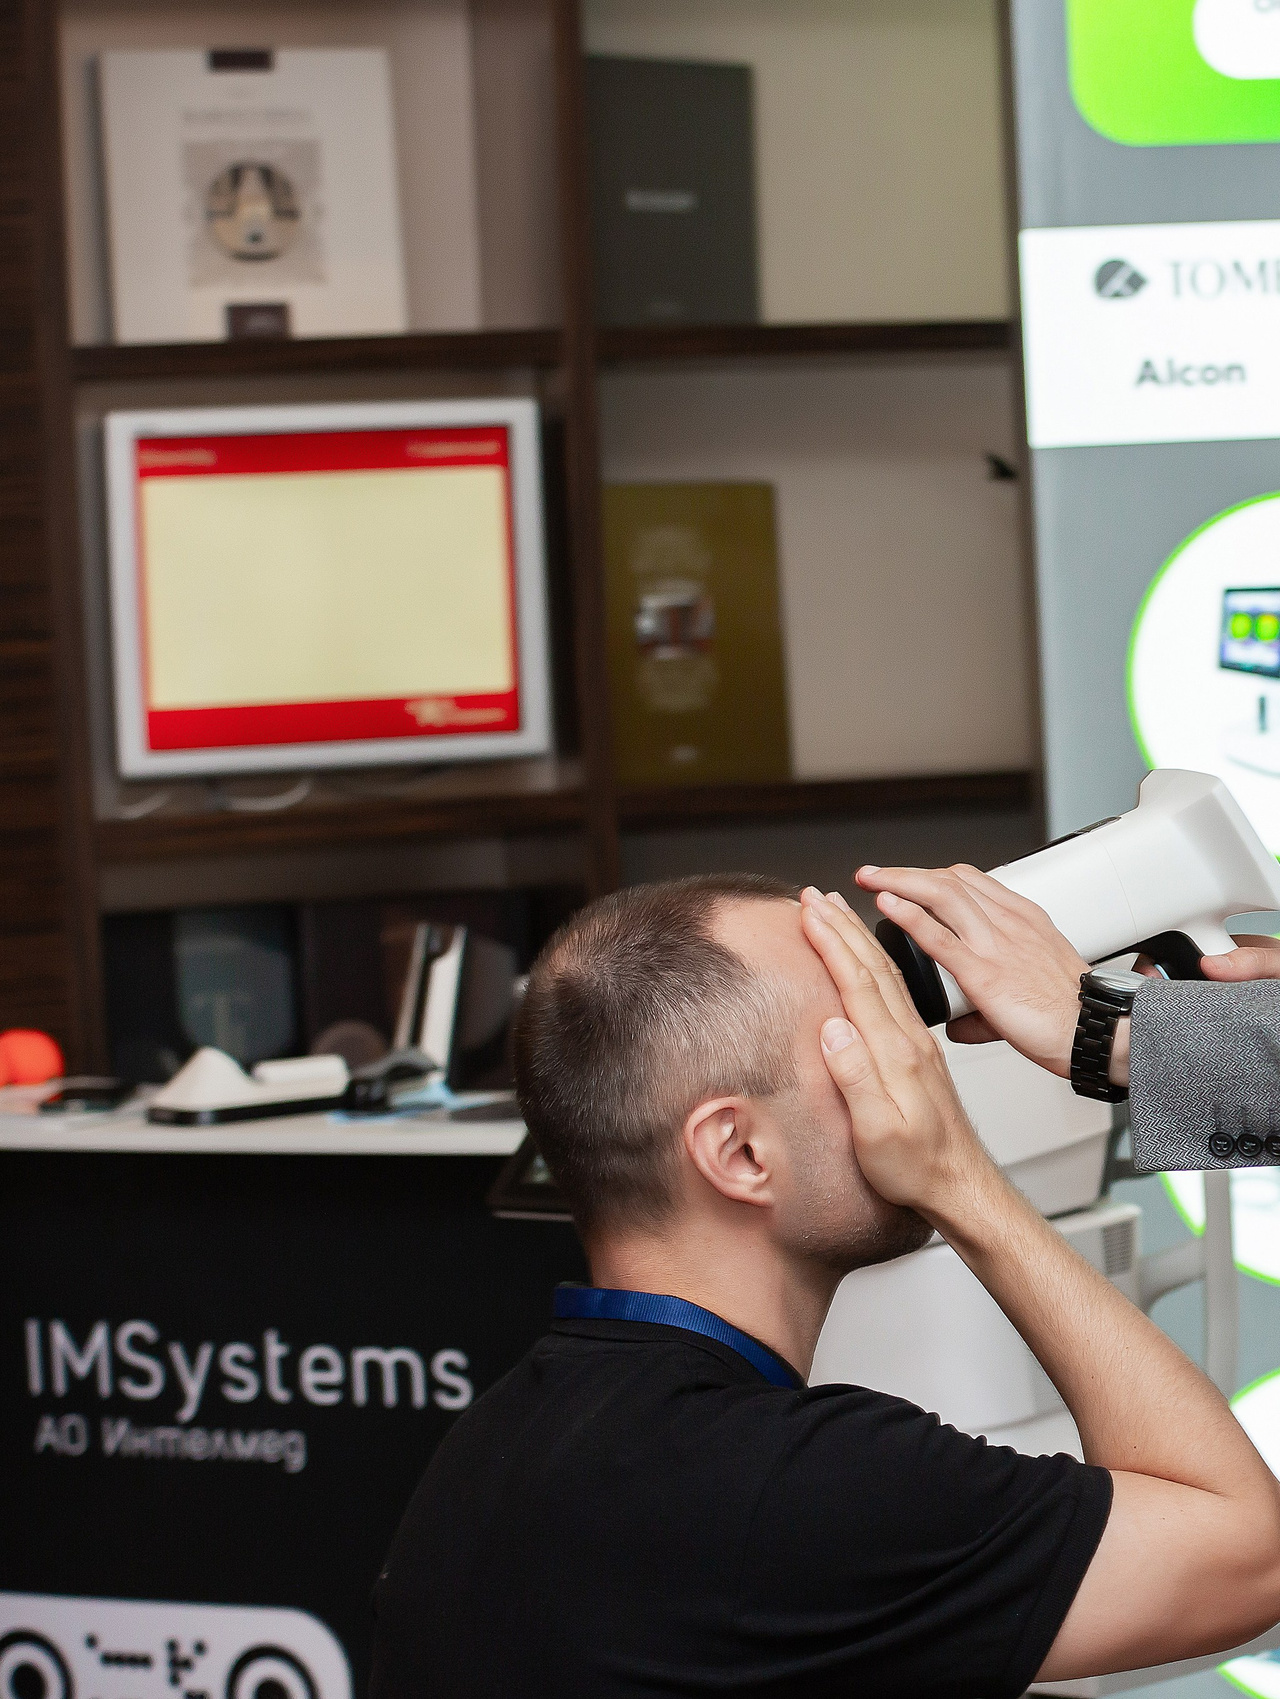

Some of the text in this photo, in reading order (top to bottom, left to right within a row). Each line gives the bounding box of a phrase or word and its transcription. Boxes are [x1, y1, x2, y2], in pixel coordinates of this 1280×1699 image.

[1133, 358, 1248, 388] Alcon
[23, 1316, 476, 1424] IMSystems
[34, 1411, 309, 1474] АО Интелмед
